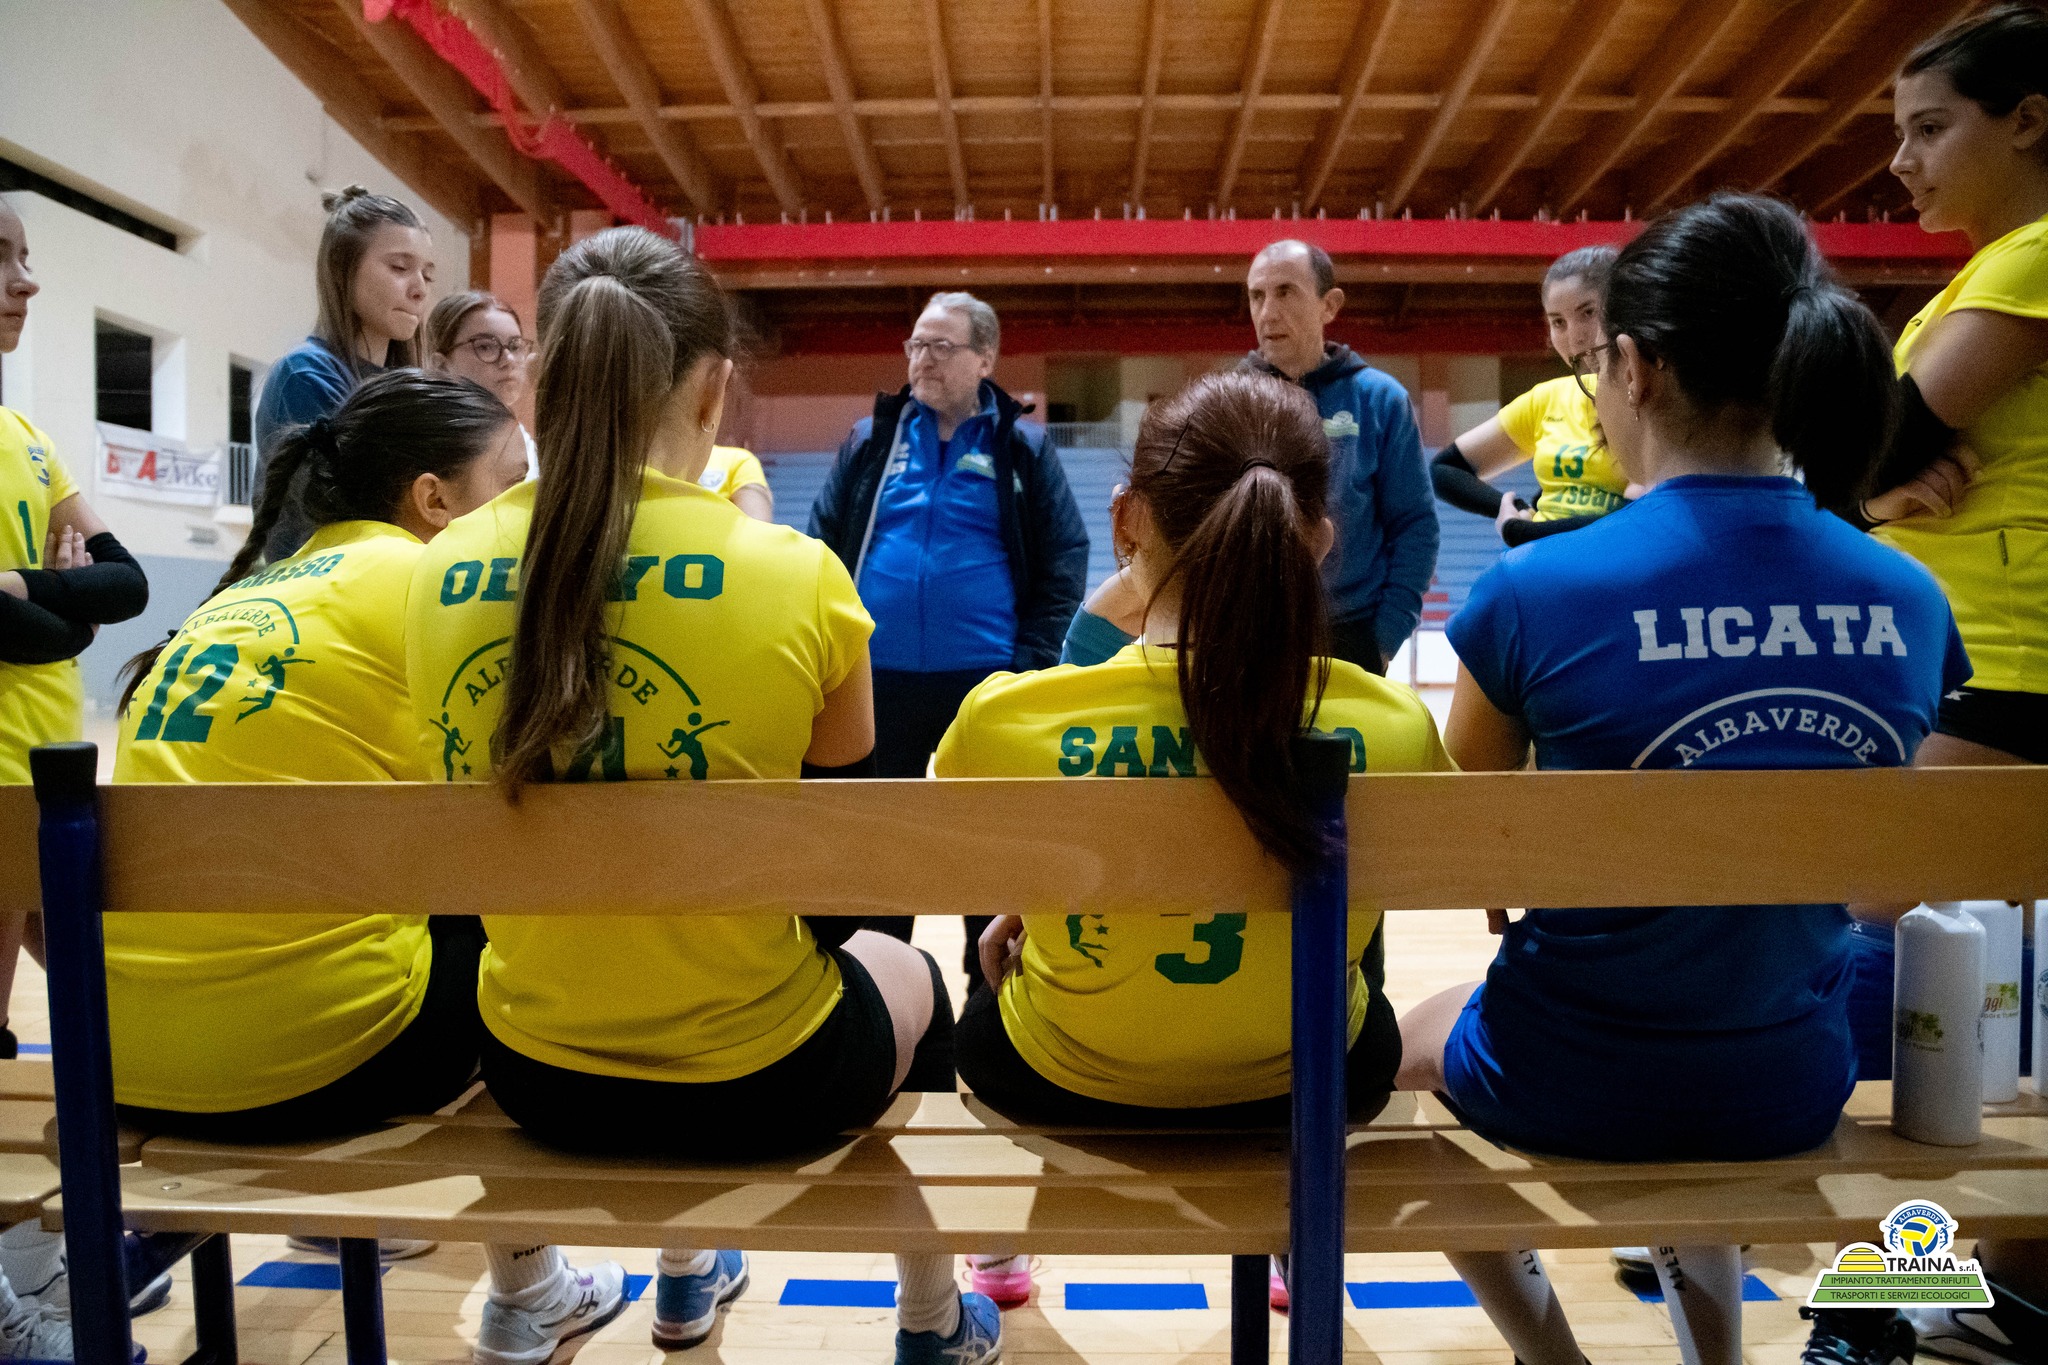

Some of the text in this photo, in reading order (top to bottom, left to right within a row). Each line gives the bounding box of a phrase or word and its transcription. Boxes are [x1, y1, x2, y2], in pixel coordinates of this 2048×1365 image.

[1553, 444, 1589, 478] 13
[18, 500, 38, 564] 1
[178, 606, 276, 638] ALBAVERDE
[1633, 605, 1907, 662] LICATA
[134, 643, 239, 742] 12
[1675, 708, 1878, 767] ALBAVERDE
